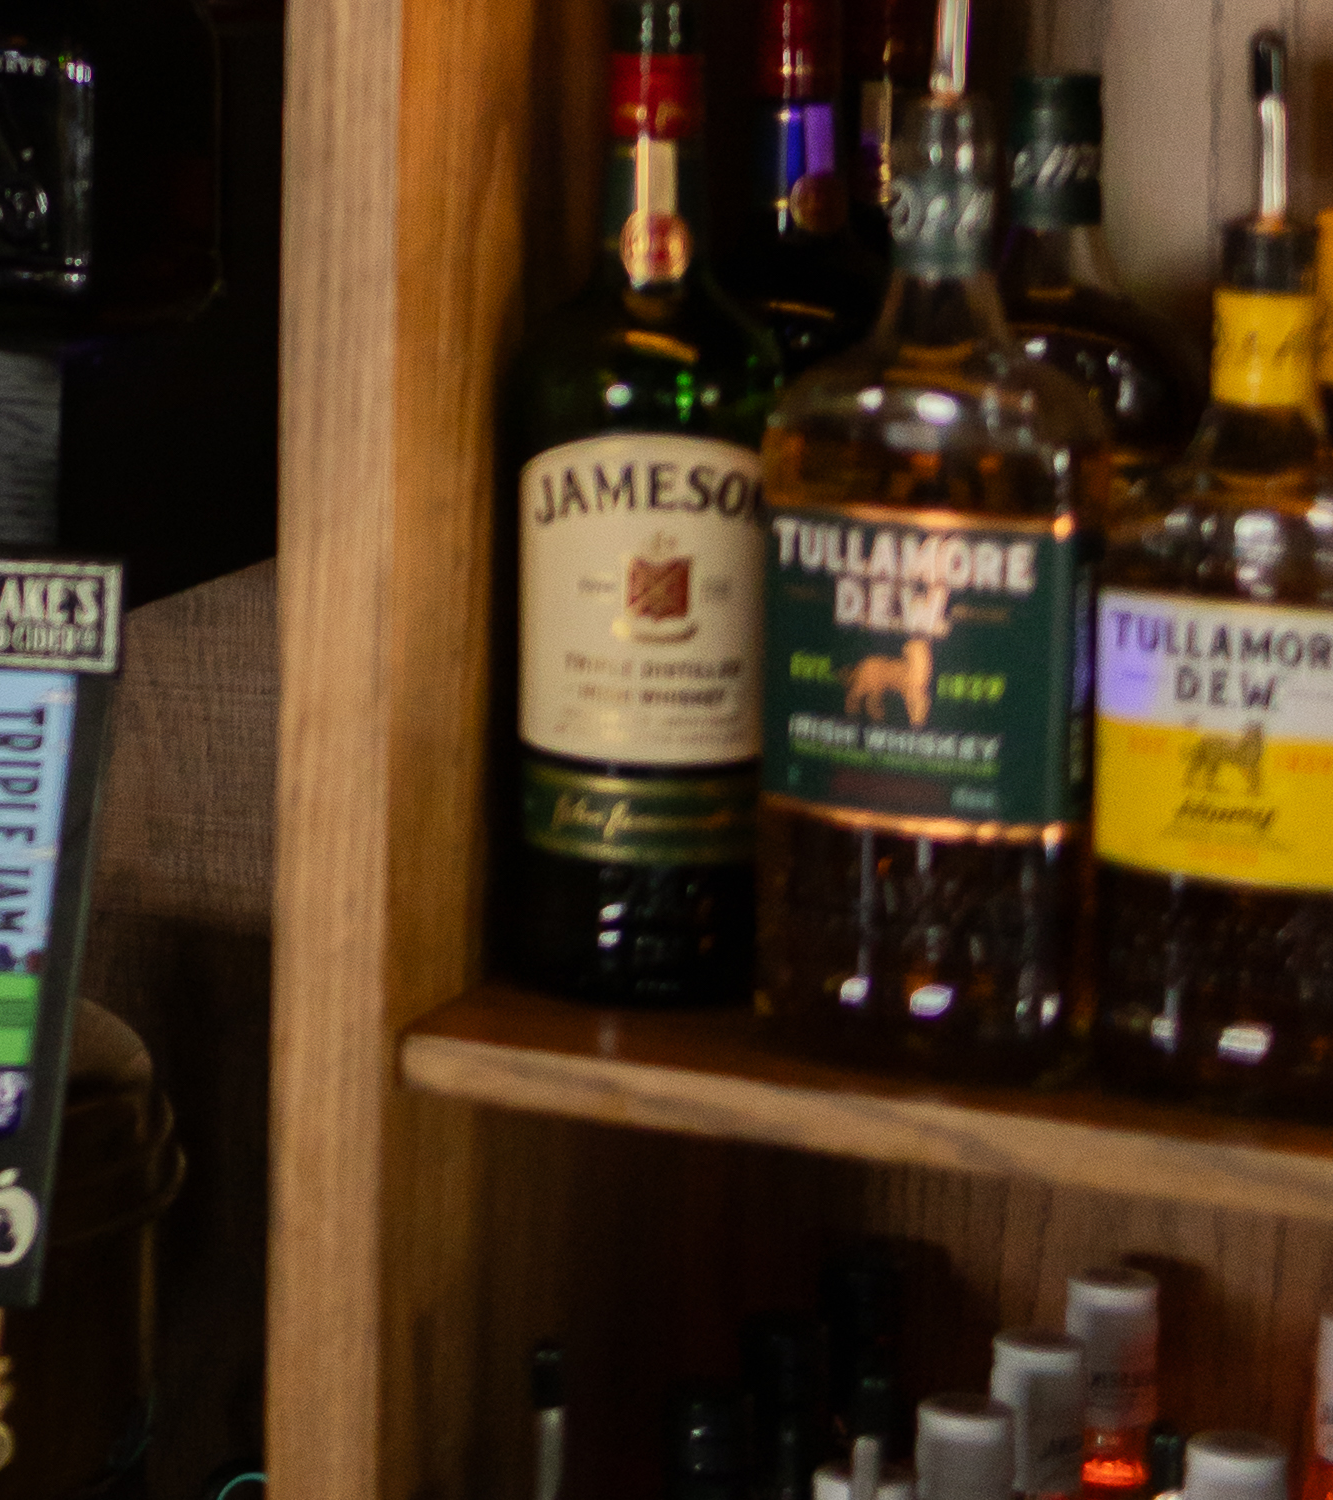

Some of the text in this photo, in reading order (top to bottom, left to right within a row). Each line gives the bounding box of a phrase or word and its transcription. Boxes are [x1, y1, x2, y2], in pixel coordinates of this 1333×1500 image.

[773, 516, 1036, 592] TULLAMORE
[1111, 611, 1333, 668] TULLAMOR
[863, 725, 1001, 760] WHISKEY
